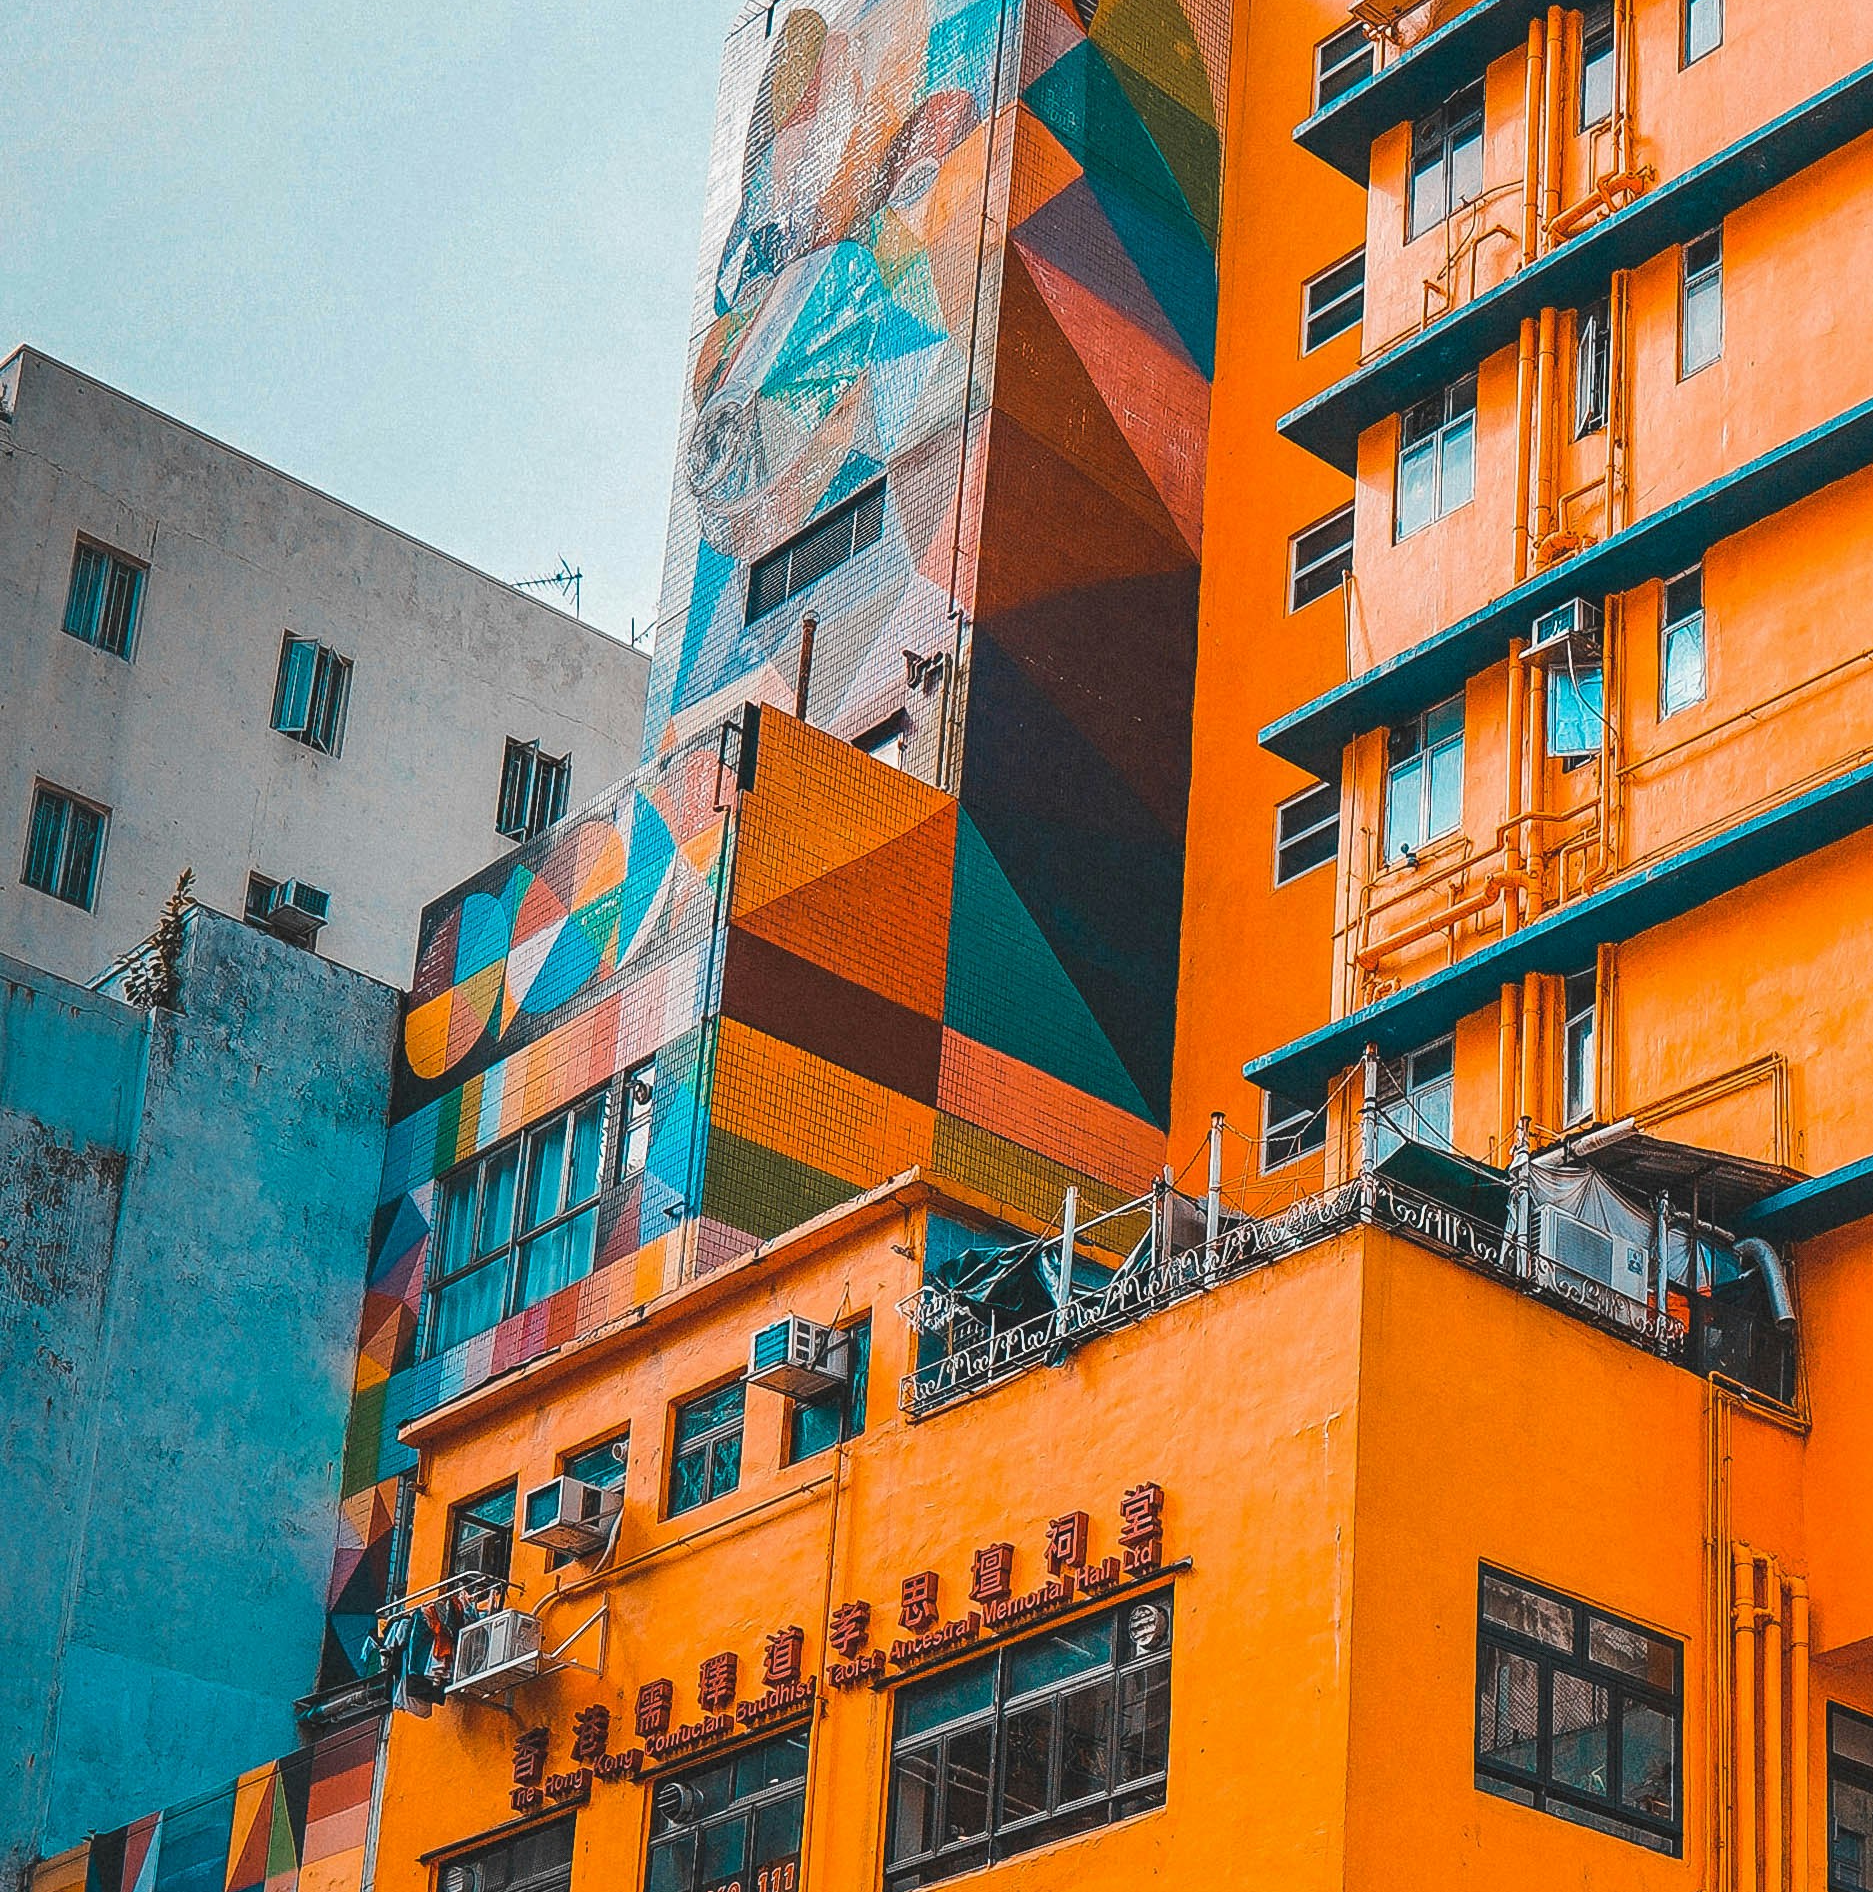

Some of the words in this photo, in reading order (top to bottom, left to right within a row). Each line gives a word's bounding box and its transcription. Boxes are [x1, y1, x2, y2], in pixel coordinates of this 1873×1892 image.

[545, 1767, 583, 1794] Hong
[593, 1749, 634, 1776] Kong
[644, 1713, 727, 1755] Confucian
[736, 1676, 815, 1723] Buddhist
[826, 1651, 880, 1686] Taoist
[889, 1617, 973, 1660] Ancestral
[980, 1580, 1066, 1627] Memorial
[1075, 1558, 1112, 1588] Hall
[1123, 1539, 1154, 1571] Ltd
